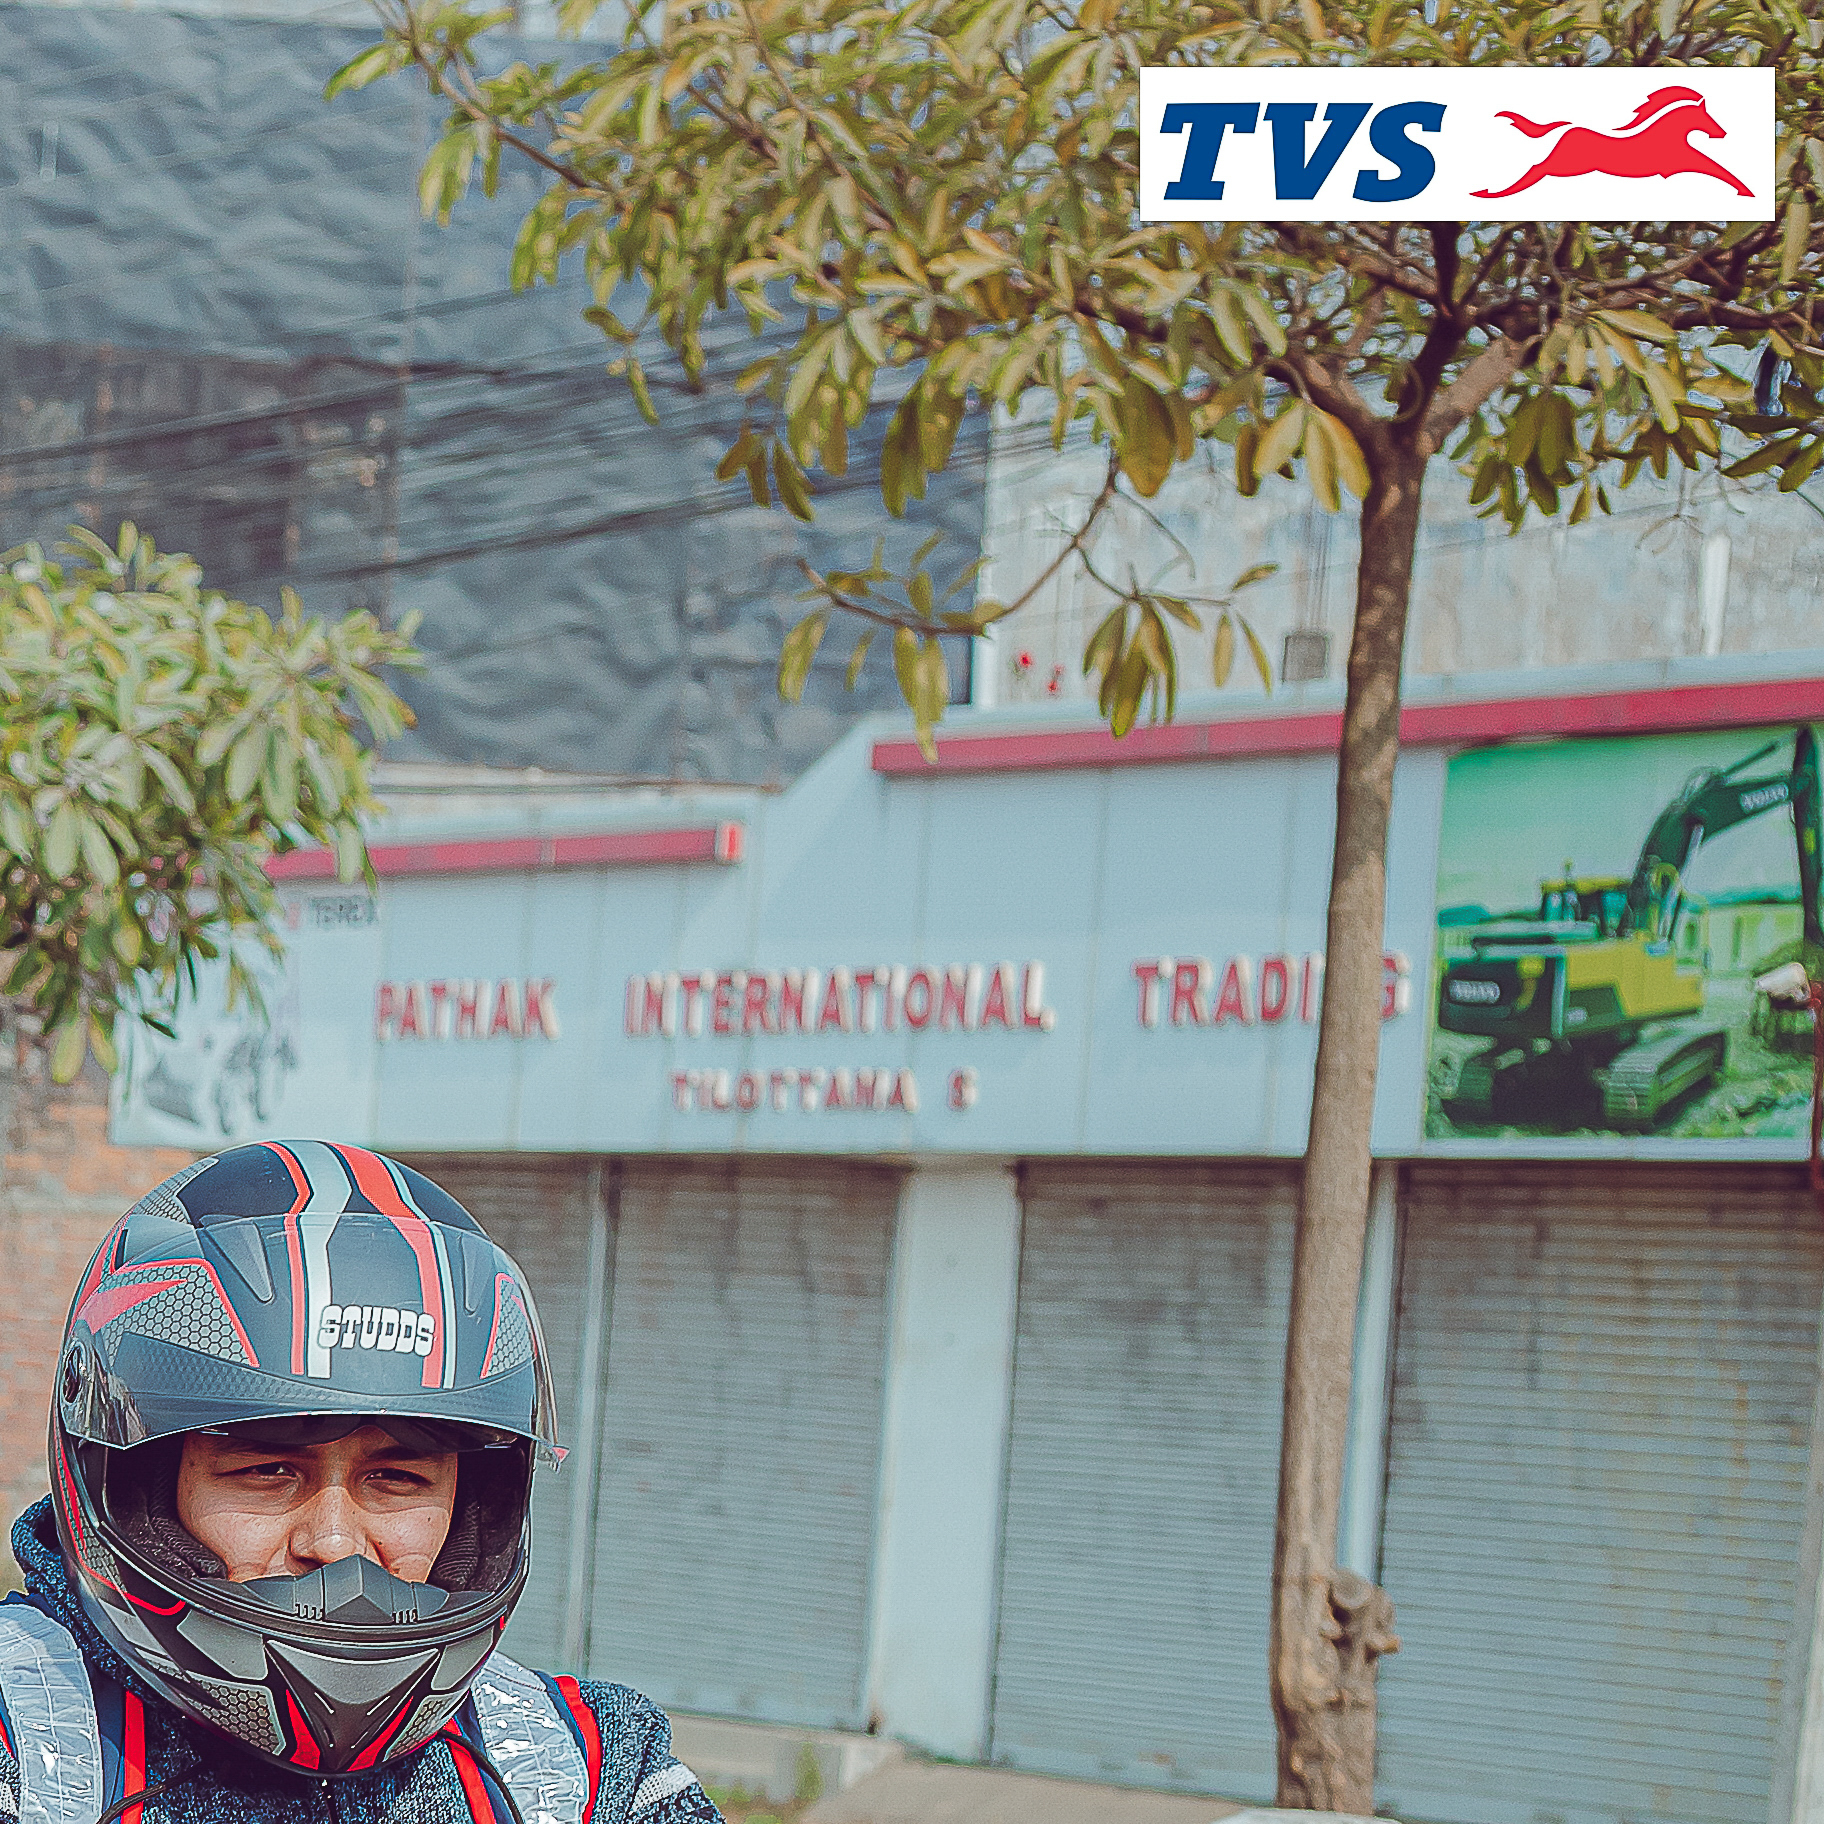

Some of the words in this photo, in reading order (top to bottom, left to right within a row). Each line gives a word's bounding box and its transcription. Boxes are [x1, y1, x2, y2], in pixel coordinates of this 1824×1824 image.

[375, 978, 560, 1041] PATHAK
[623, 960, 1057, 1037] INTERNATIONAL
[1131, 950, 1411, 1028] TRADIG
[317, 1304, 435, 1357] STUDDS
